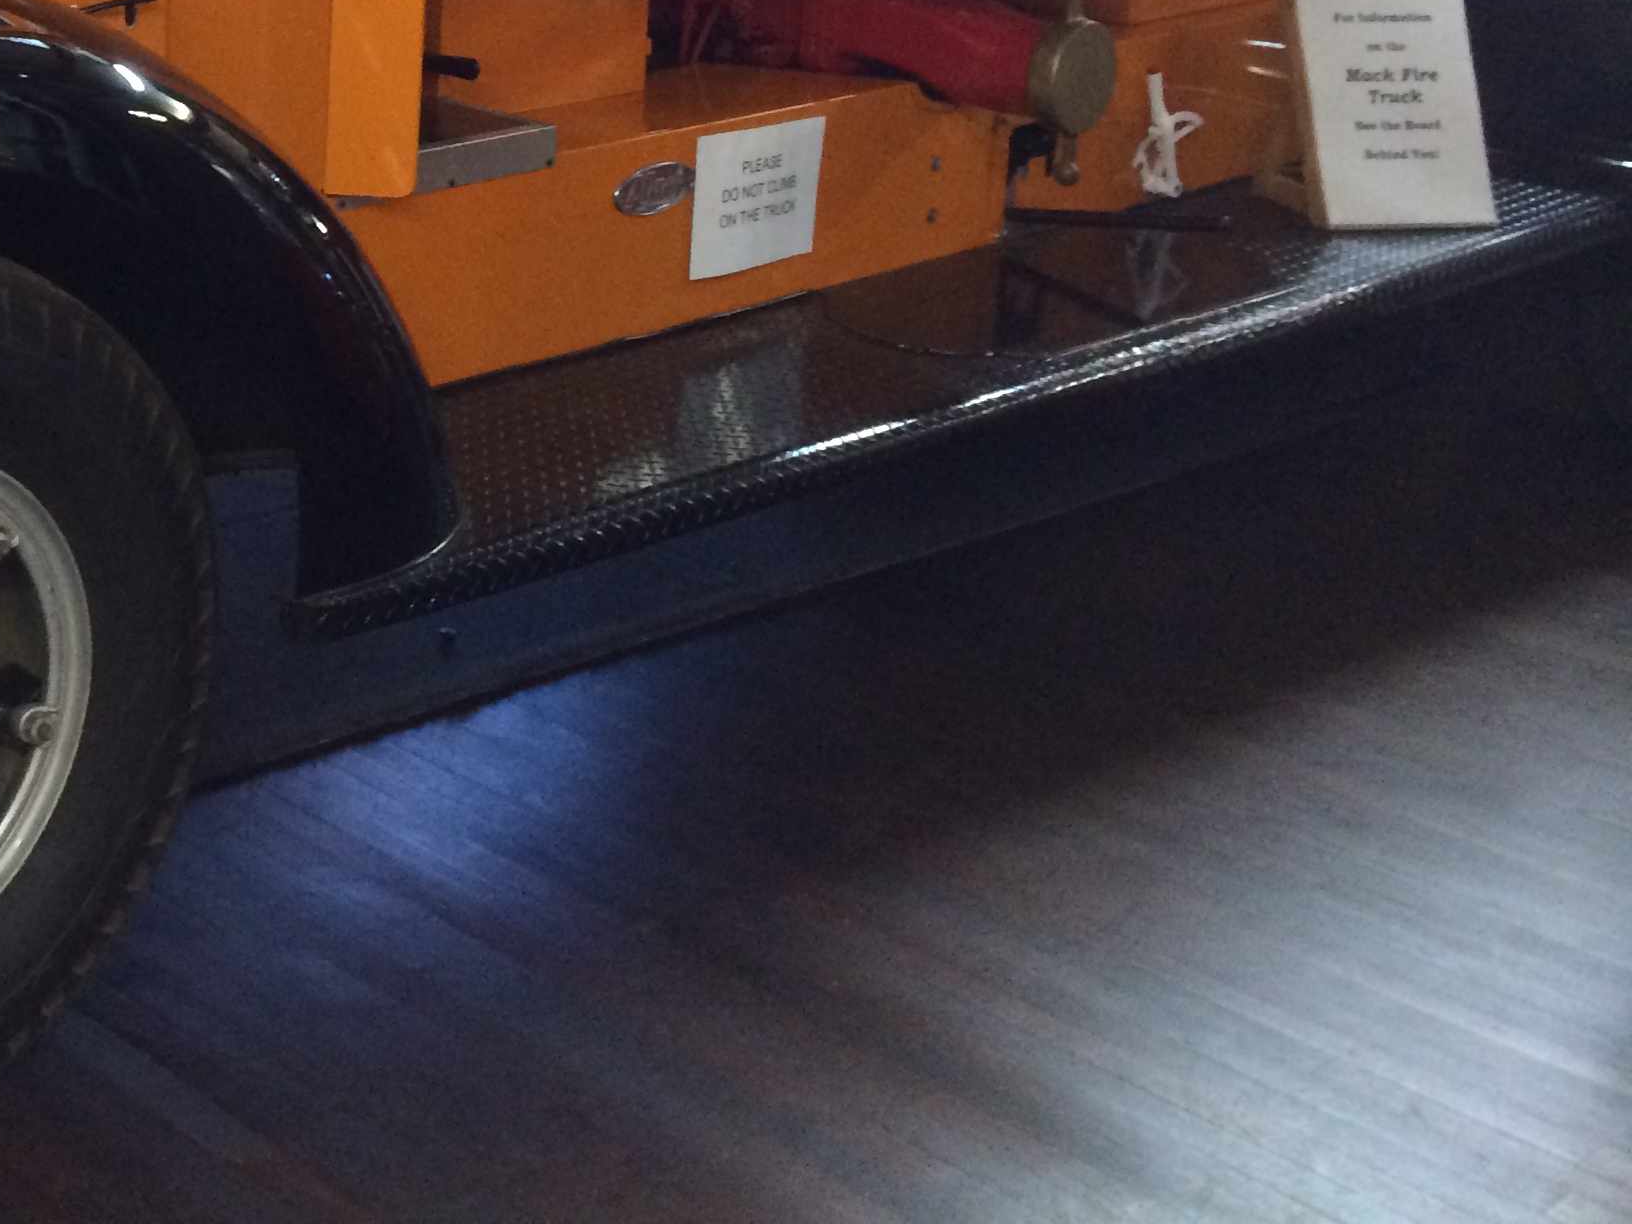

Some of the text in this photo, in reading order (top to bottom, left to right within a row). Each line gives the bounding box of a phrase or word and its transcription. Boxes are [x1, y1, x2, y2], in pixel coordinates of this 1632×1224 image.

[1358, 12, 1432, 24] Information
[1346, 68, 1438, 82] Mack Fire
[1368, 89, 1423, 104] Truck
[741, 153, 783, 174] PLEASE
[721, 174, 797, 203] DO NOT CLIMB
[719, 198, 797, 229] ON THE TRUCK
